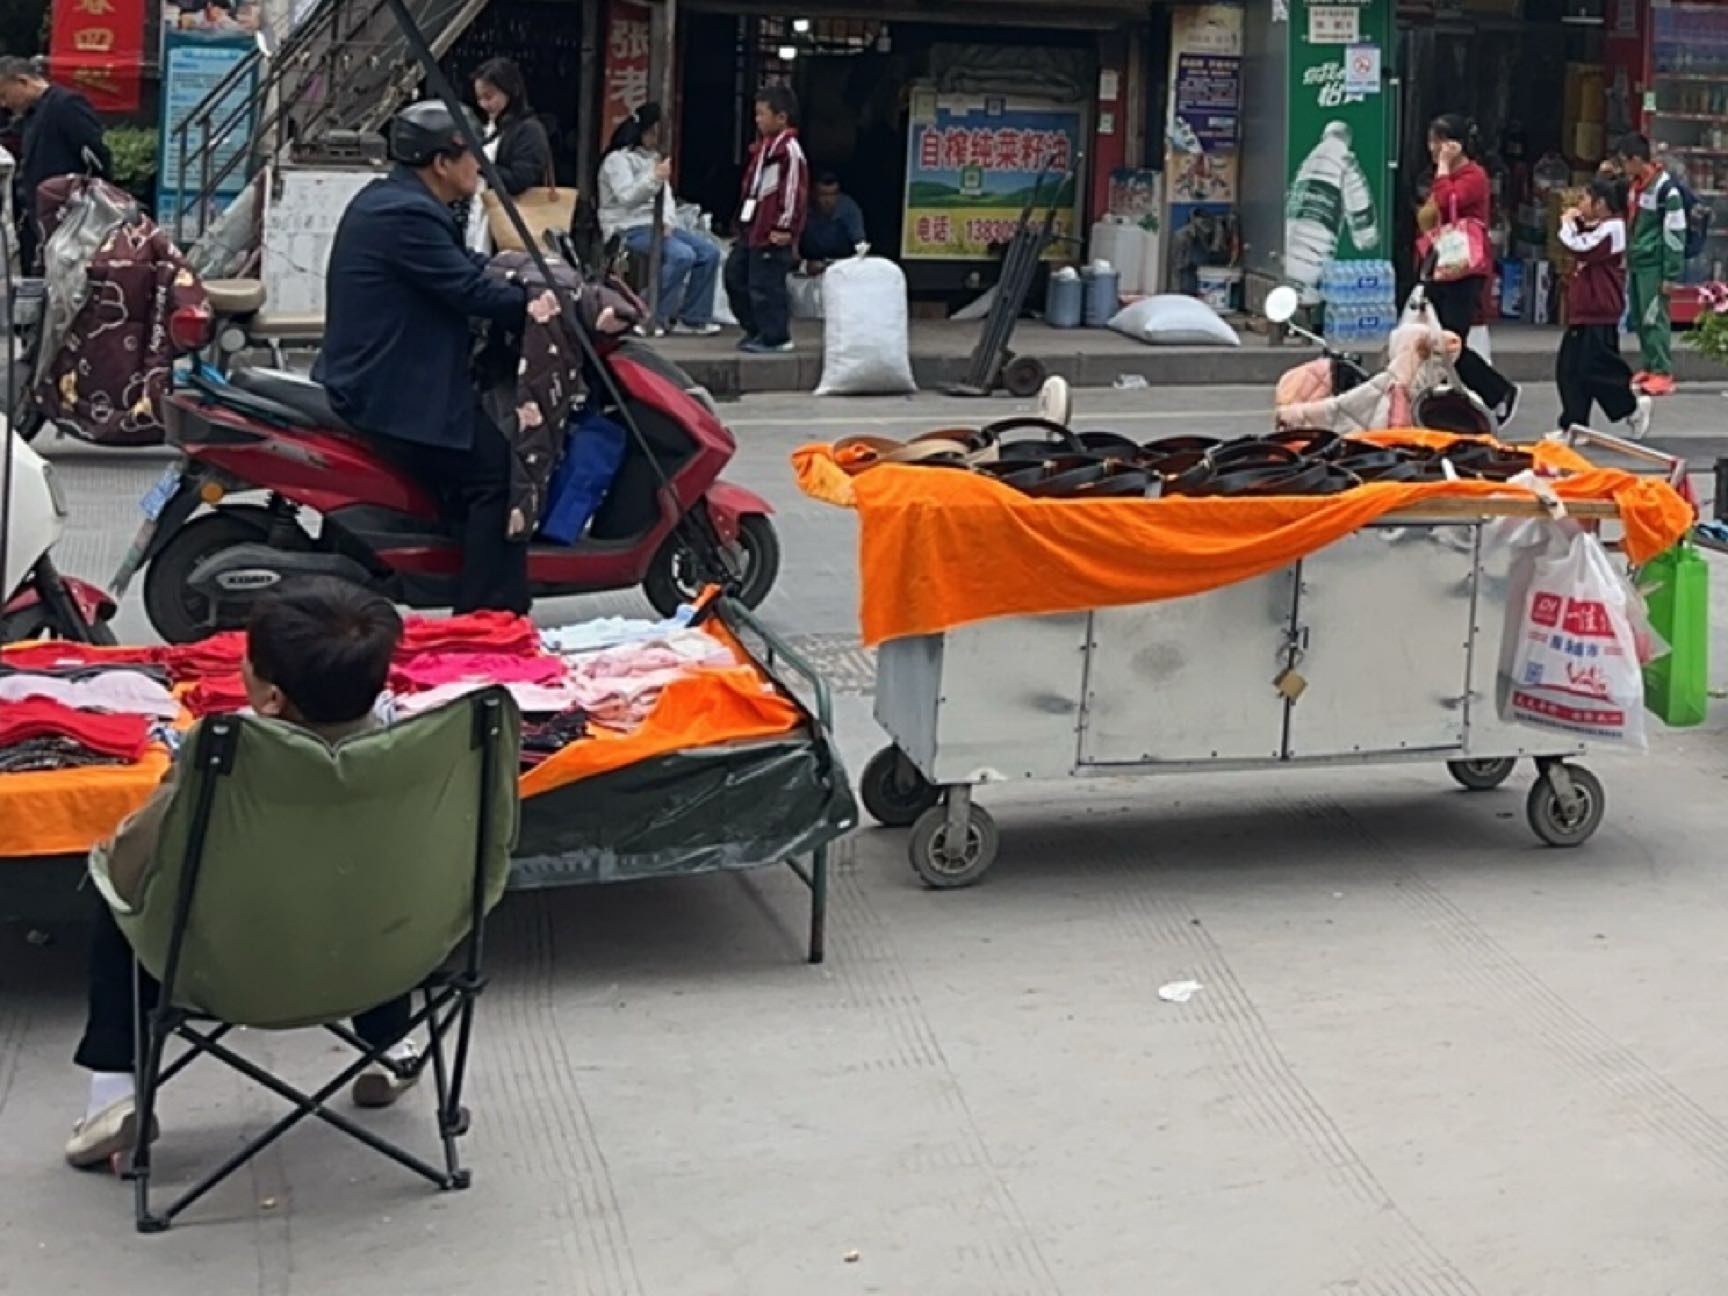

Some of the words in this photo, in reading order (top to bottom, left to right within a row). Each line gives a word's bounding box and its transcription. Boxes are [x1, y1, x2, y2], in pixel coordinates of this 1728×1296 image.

[921, 125, 1070, 172] 自榨纯菜籽油
